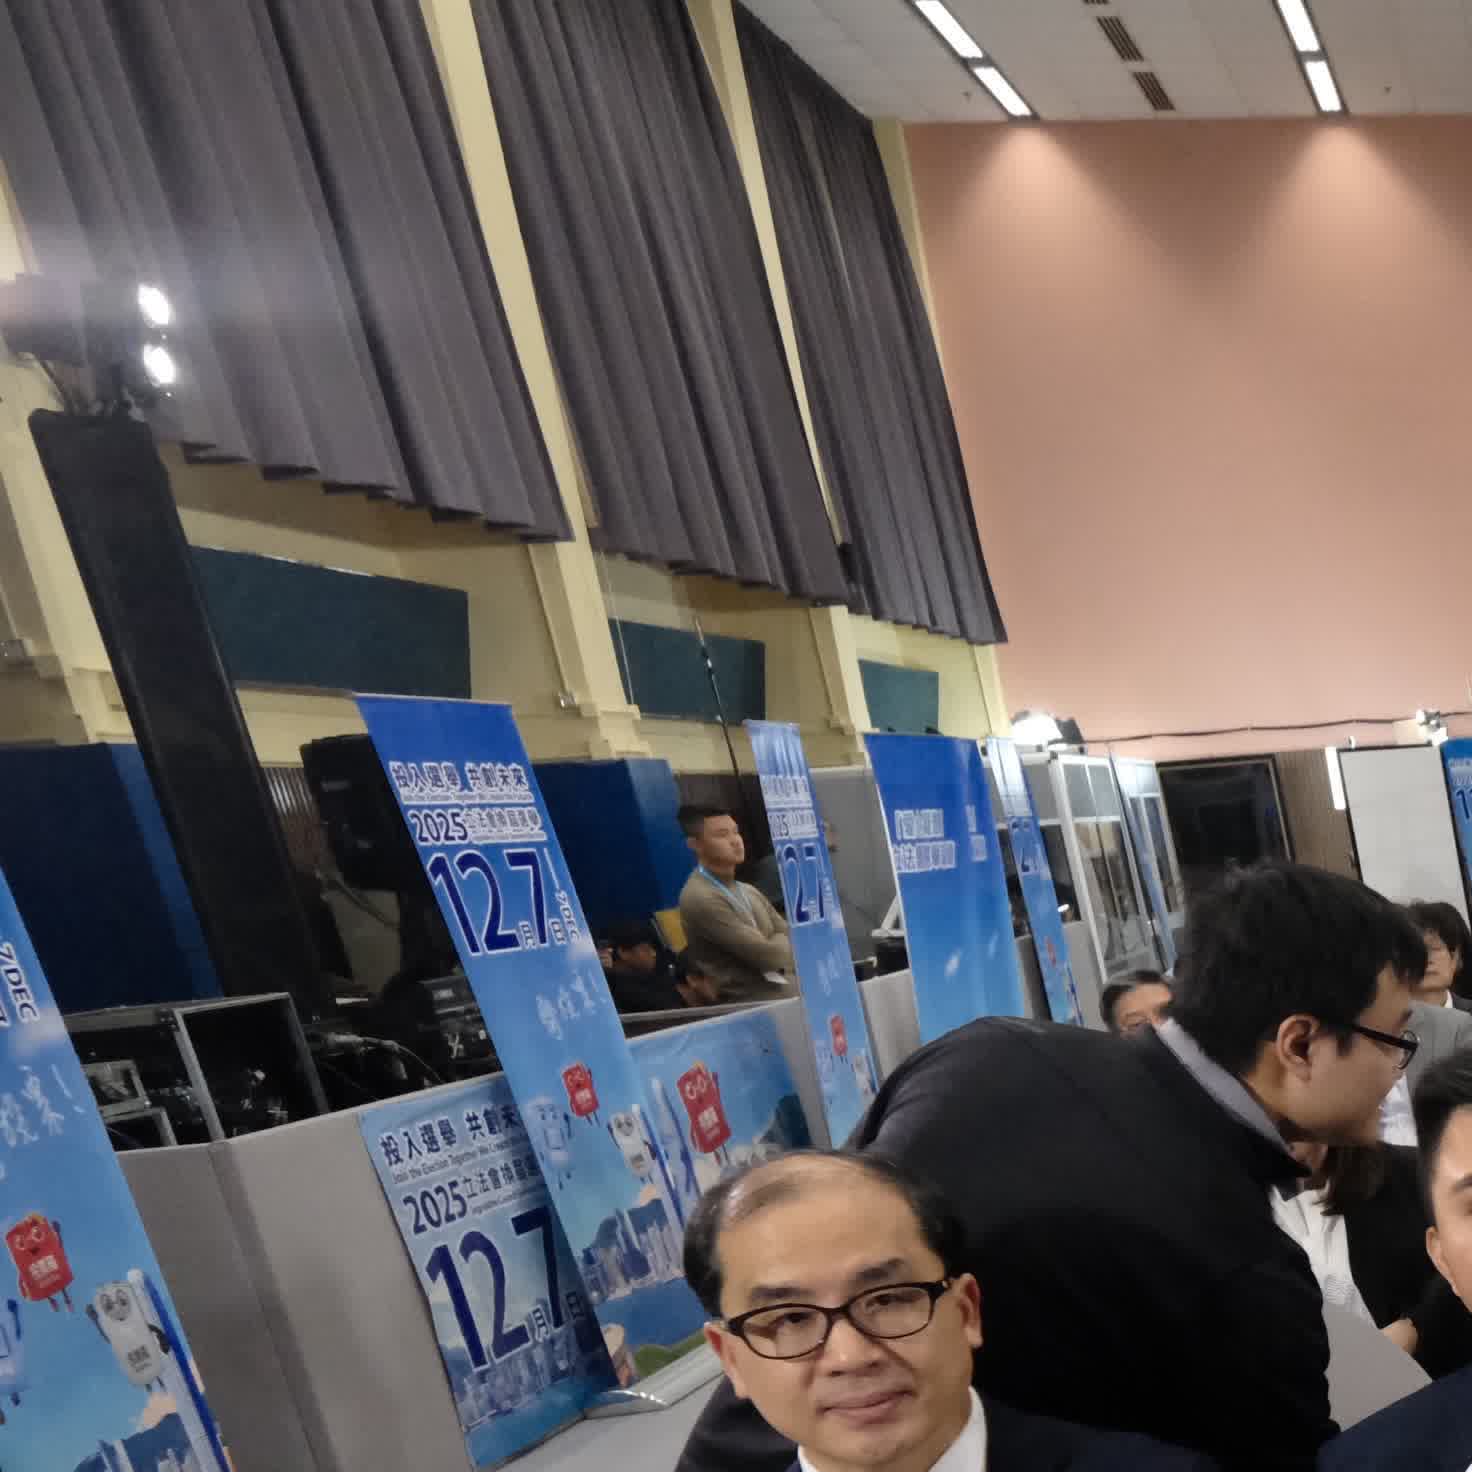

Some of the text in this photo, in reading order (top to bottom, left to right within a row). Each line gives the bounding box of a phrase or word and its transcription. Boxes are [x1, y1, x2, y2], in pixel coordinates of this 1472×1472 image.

[378, 1117, 457, 1168] 投入選舉
[402, 1178, 468, 1236] 2025
